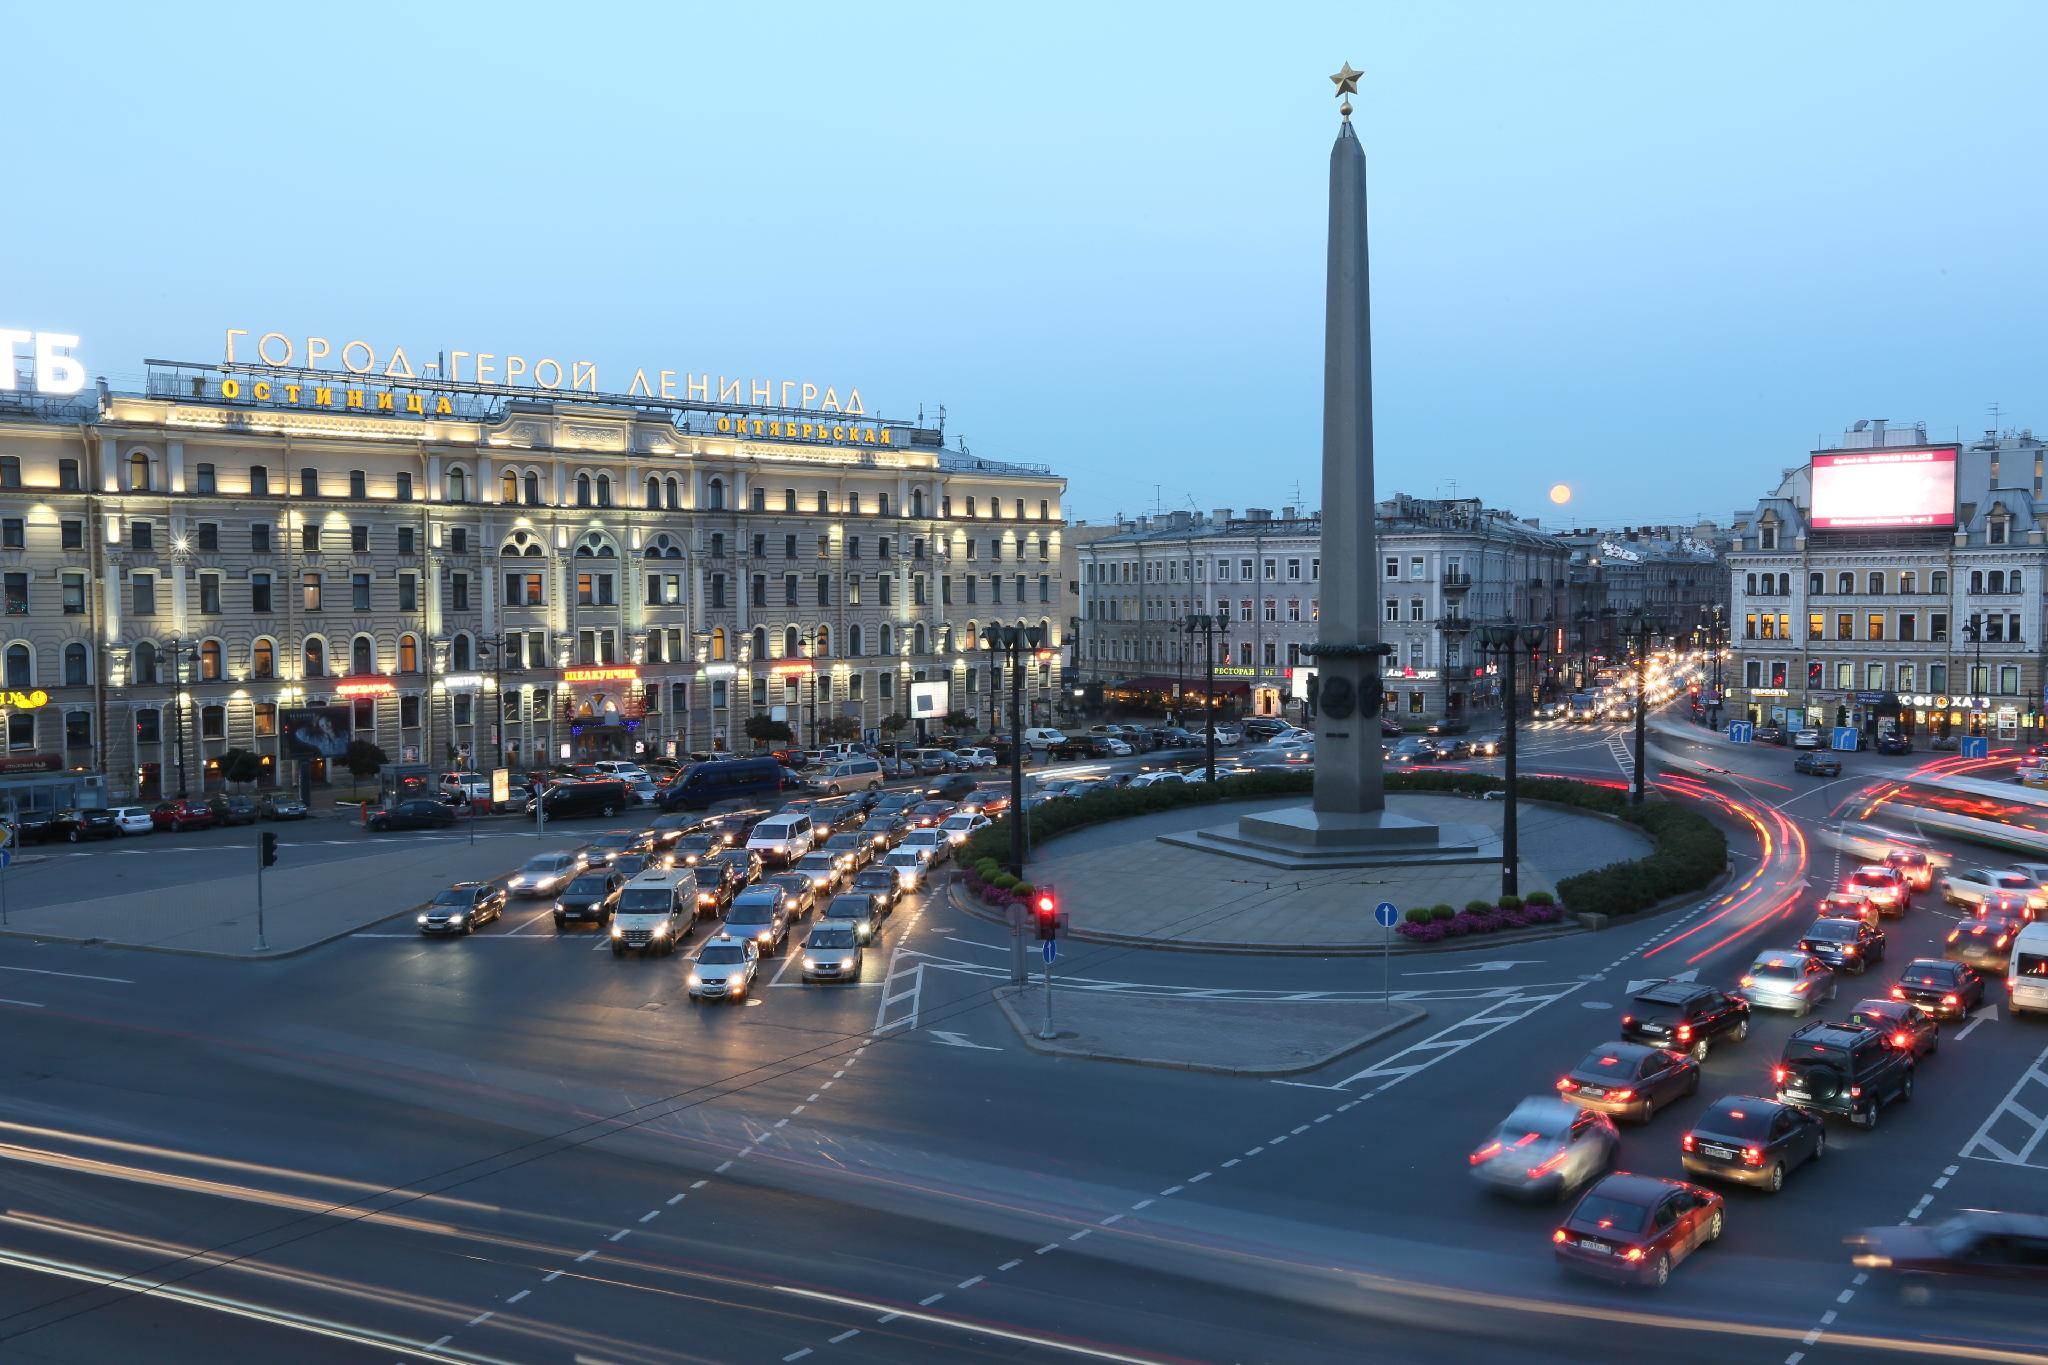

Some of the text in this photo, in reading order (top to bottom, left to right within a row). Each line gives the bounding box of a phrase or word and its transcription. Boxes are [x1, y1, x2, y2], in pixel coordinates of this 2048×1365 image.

[225, 328, 866, 415] ГОРОД-ГЕРОЙ ЛЕНИНГРАД
[717, 415, 891, 445] ОКТЯБРЬСКАЯ
[564, 668, 637, 681] ЩЕЛКУНЧИК
[1214, 667, 1255, 676] РЕСТОРАН
[1951, 697, 1990, 708] ХАЗ
